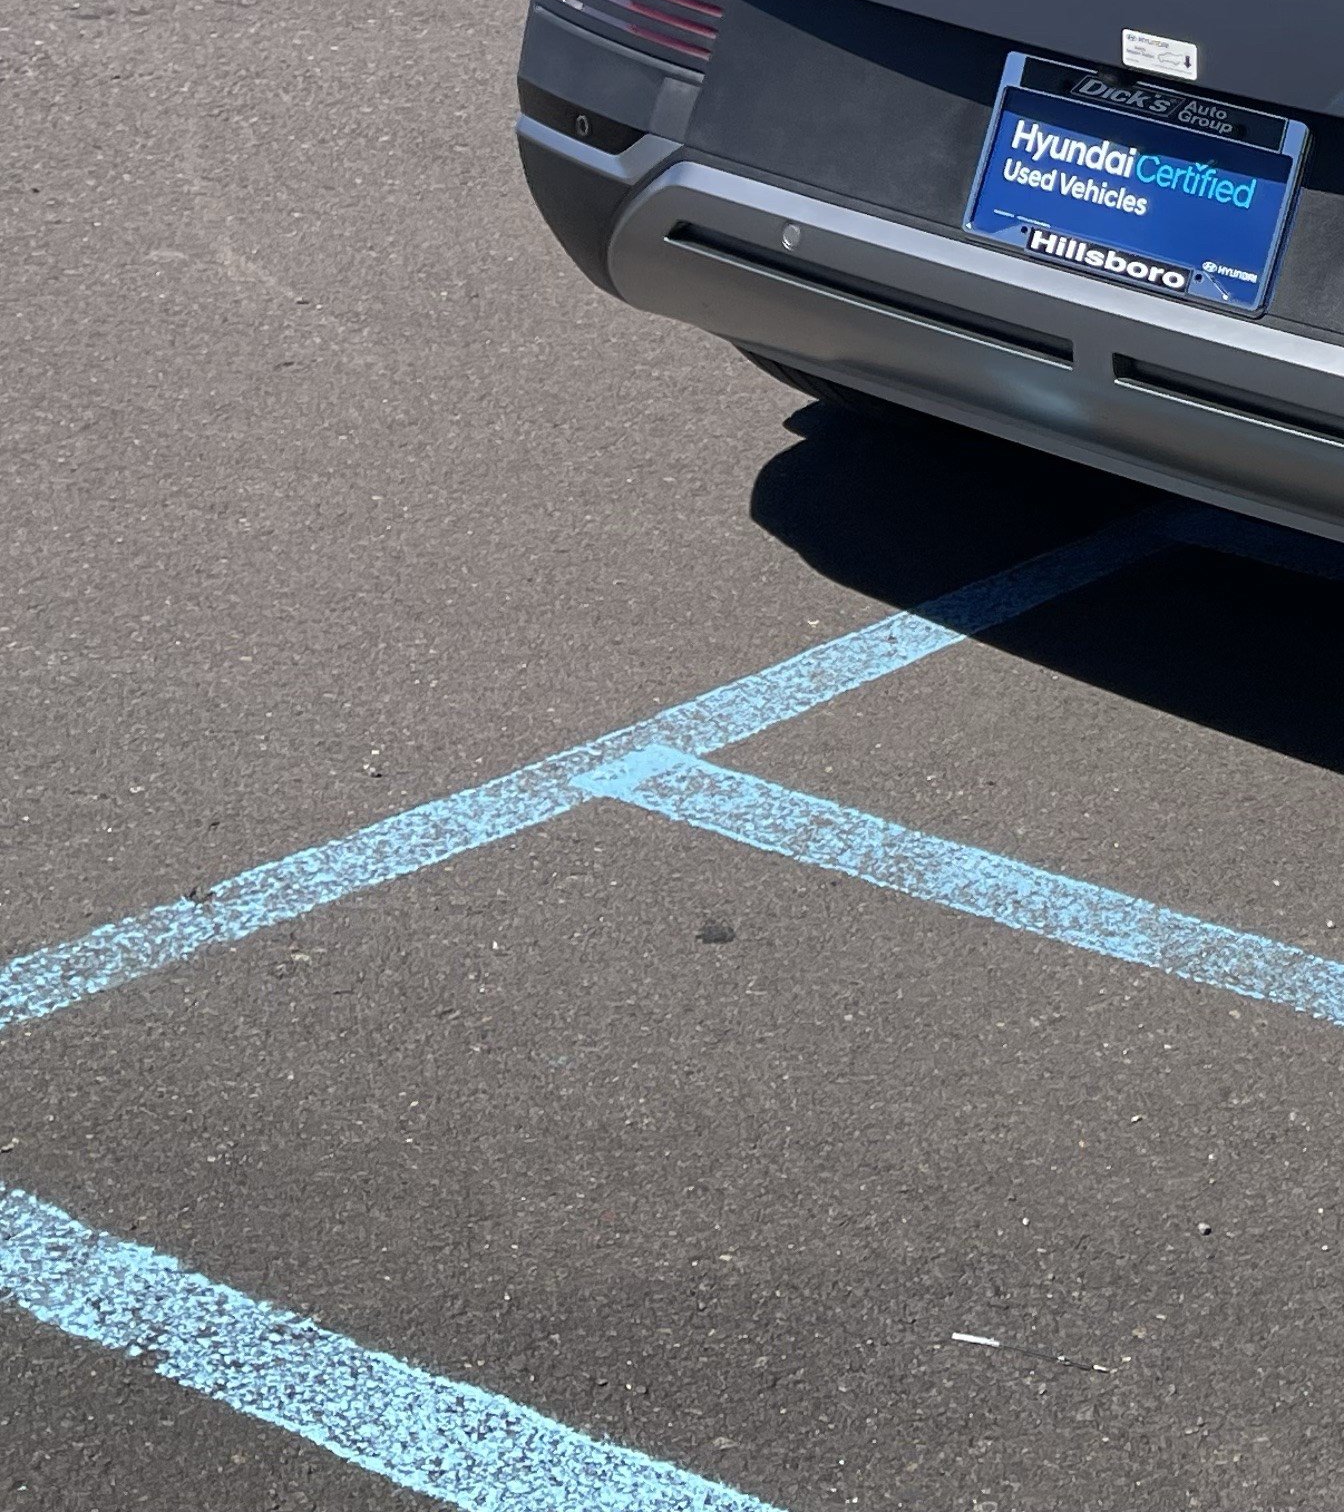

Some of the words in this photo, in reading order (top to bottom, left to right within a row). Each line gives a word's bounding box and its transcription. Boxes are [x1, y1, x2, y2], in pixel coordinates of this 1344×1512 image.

[1178, 111, 1234, 134] Group
[1184, 100, 1228, 120] Auto
[1003, 158, 1058, 192] Used
[1060, 172, 1149, 216] Vehicles
[1011, 119, 1138, 178] Hyundai
[1136, 154, 1258, 209] Certified
[1031, 229, 1186, 289] Hillsboro
